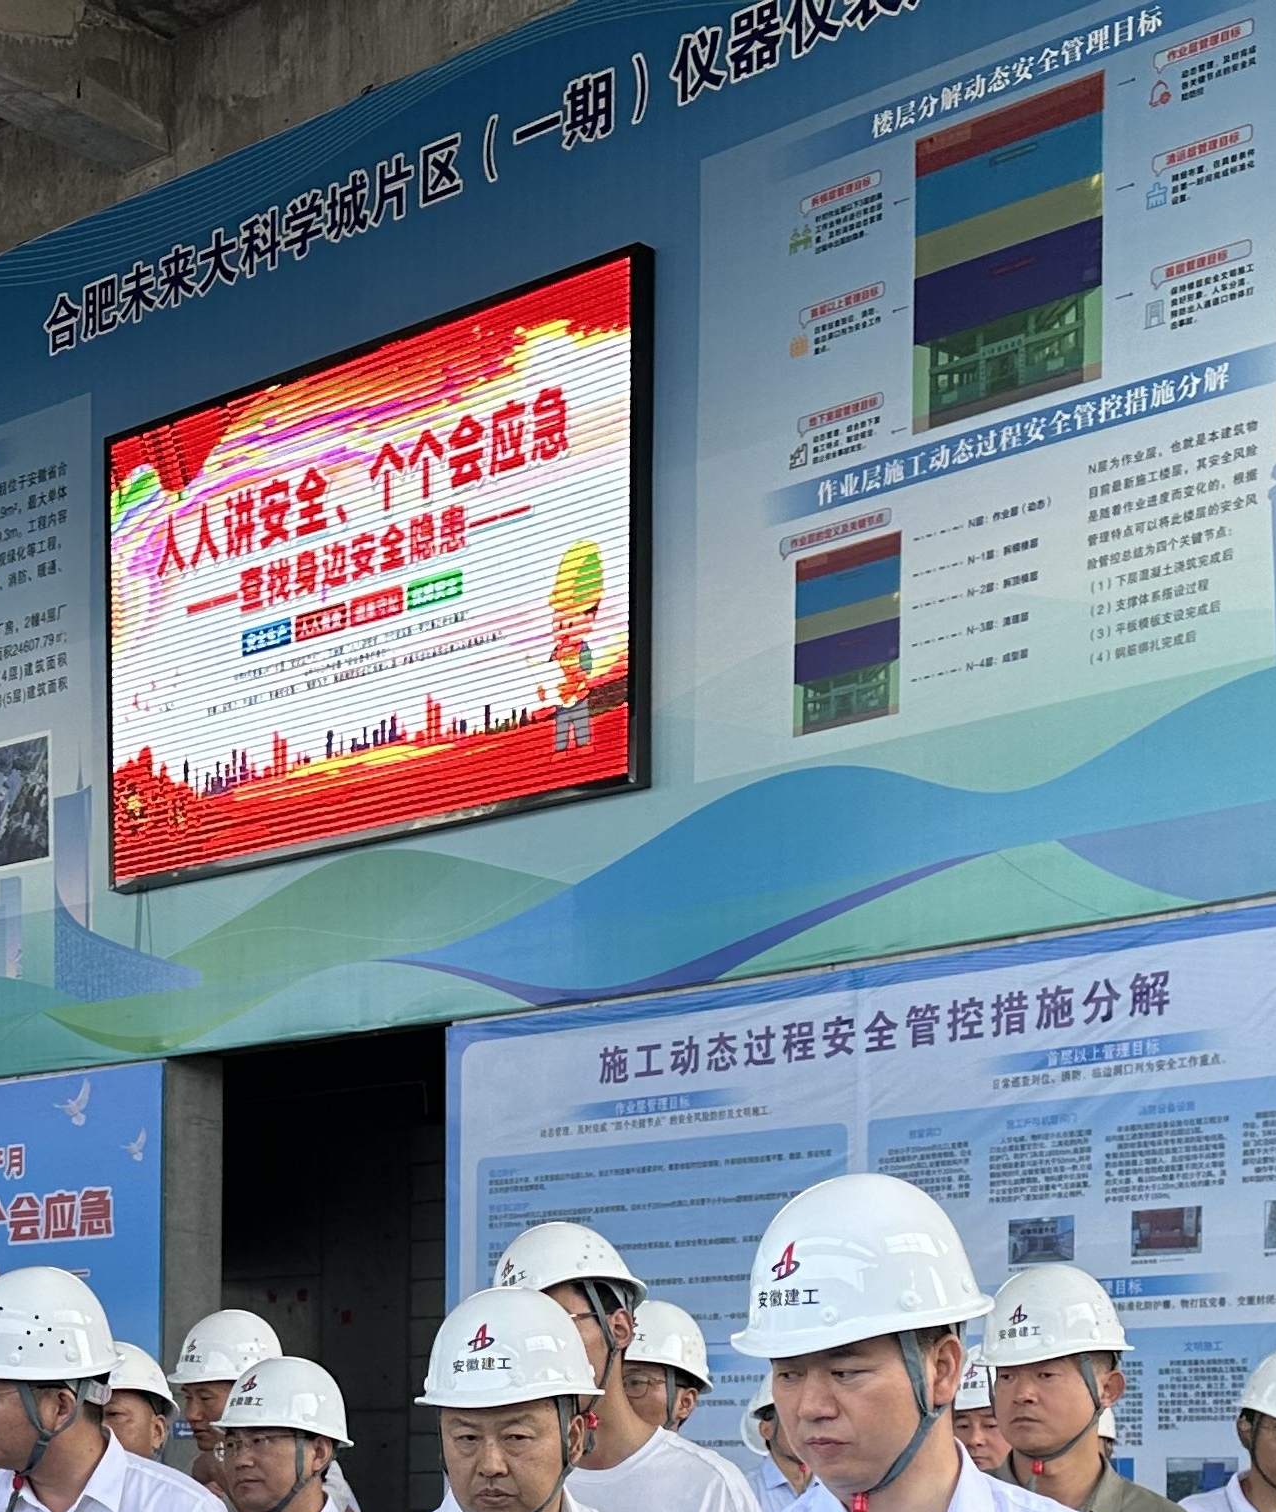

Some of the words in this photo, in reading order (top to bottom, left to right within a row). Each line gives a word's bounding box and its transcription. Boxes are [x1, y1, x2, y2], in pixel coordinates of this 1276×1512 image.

[1167, 26, 1241, 61] 作业层管理目标
[872, 6, 1163, 140] 楼层分解动态安全管理目标
[816, 362, 1231, 507] 作业层施工动态过程安全管控措施分解
[158, 387, 570, 579] 人人讲安全、个个会应急
[1088, 493, 1258, 547] 管理特点可以将此楼层的安全风
[599, 967, 1173, 1086] 施工动态过程安全管控措施分解
[1046, 1038, 1160, 1068] 首层以上管理目标
[615, 1094, 691, 1116] 作业层管理目标
[758, 1288, 820, 1309] 安徽建工
[452, 1356, 512, 1374] 安徽建工
